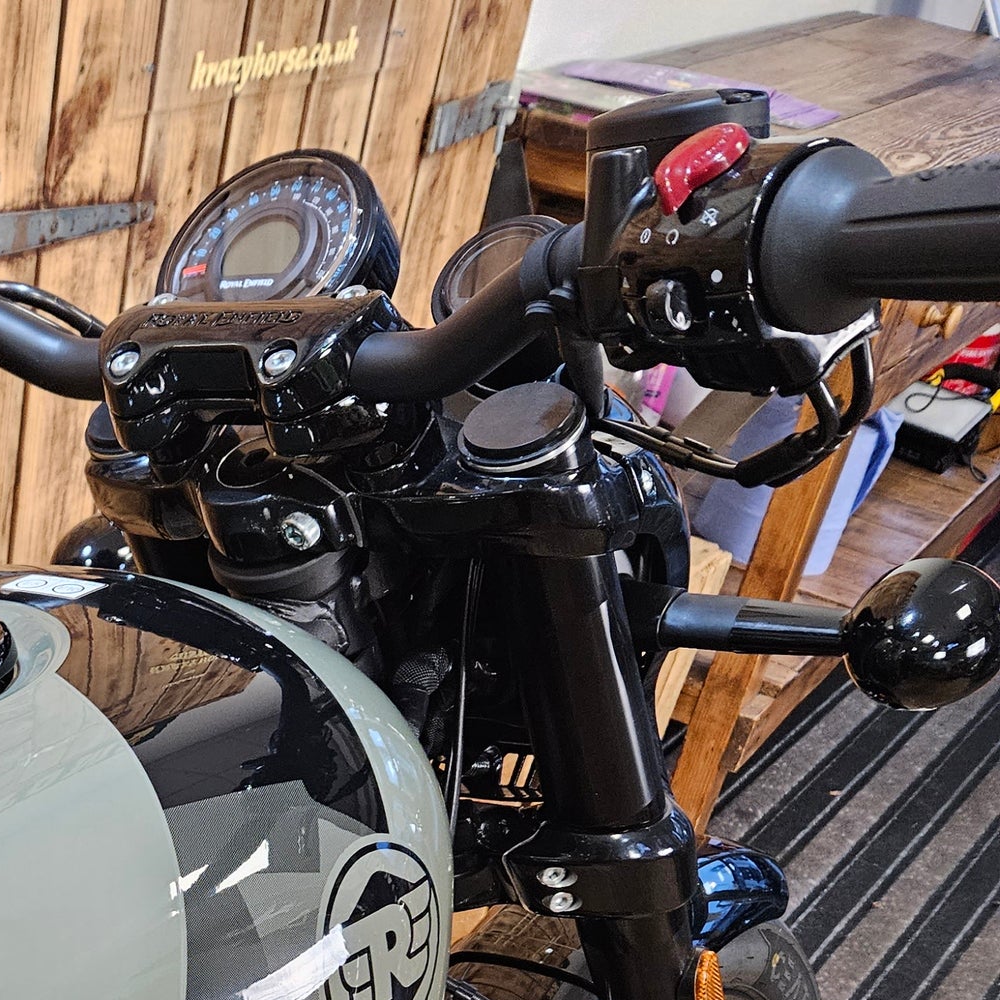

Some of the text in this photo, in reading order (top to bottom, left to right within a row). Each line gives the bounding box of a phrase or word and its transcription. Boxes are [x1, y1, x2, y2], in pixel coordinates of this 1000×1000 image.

[190, 25, 359, 94] krazyhorse.co.uk
[219, 278, 274, 289] ROYAL ENFIELD
[211, 310, 303, 327] ENFIELD
